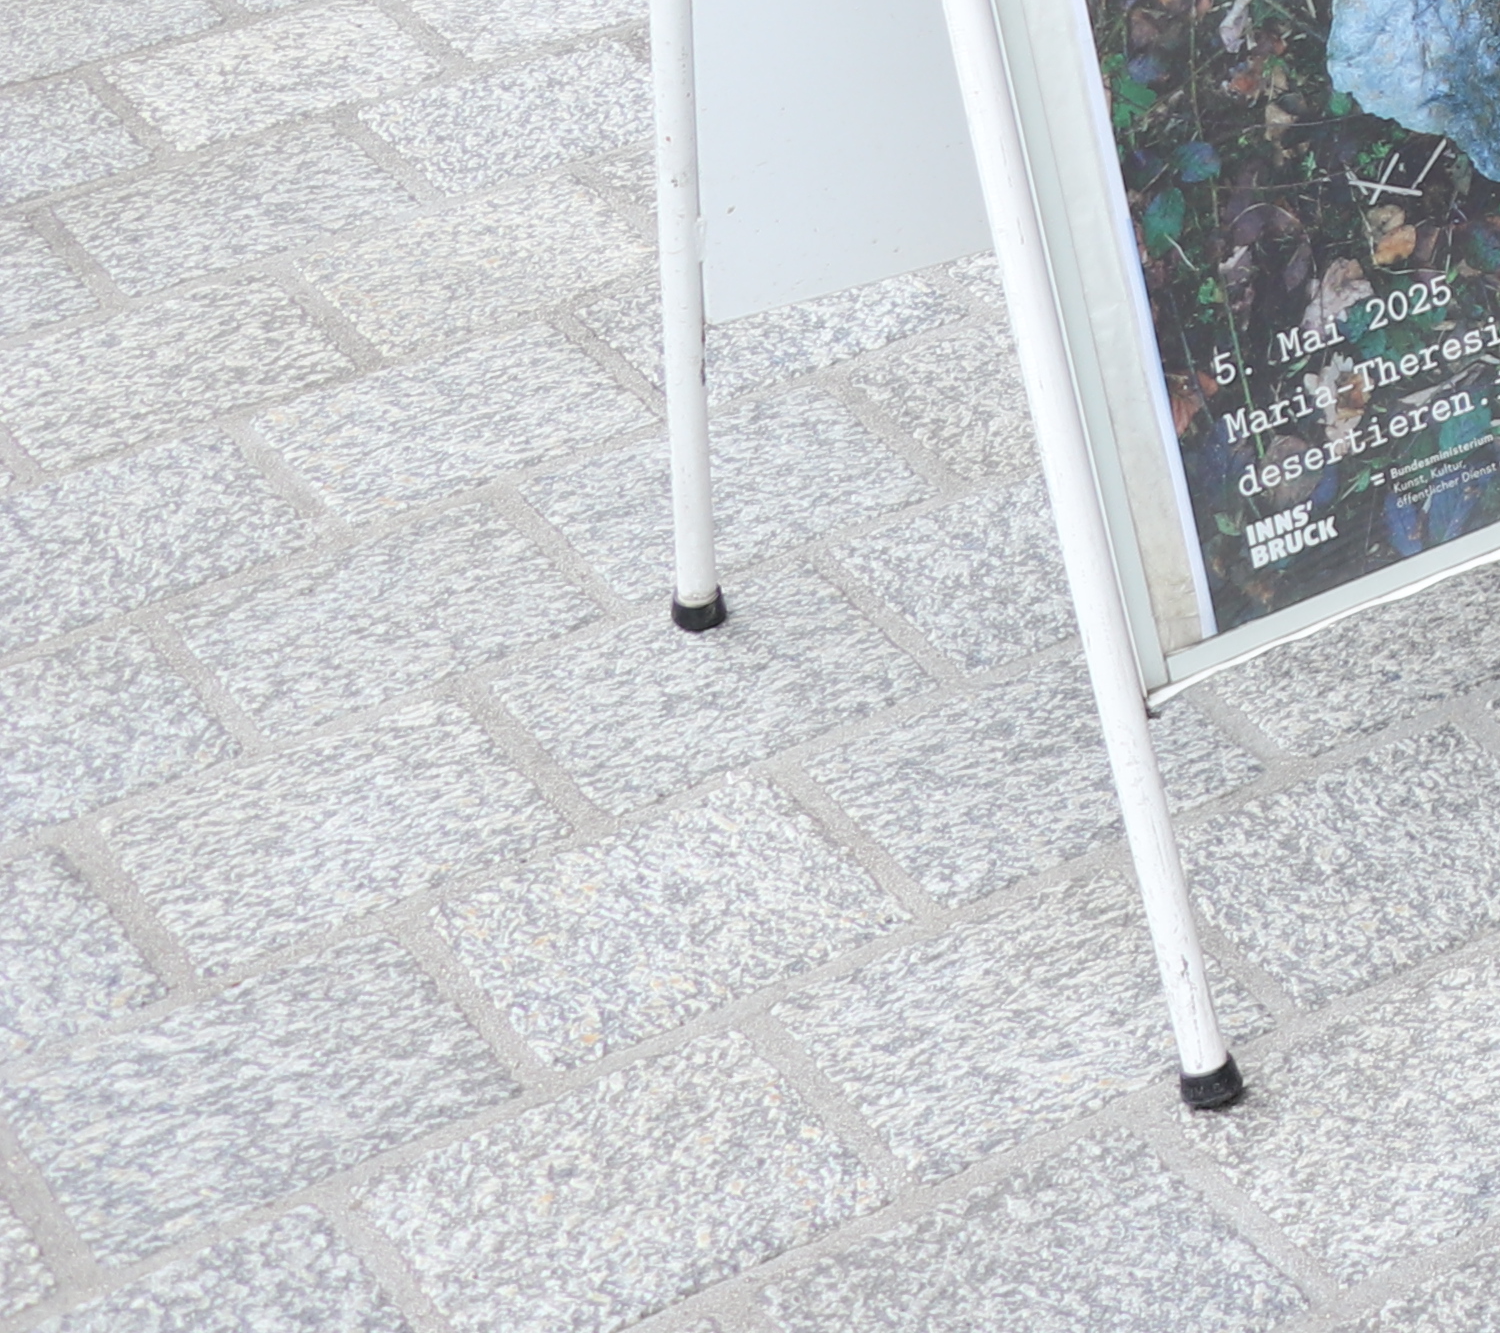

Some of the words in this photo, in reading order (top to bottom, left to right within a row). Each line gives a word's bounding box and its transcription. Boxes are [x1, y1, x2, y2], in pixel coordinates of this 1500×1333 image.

[1212, 345, 1254, 386] 5.
[1278, 313, 1343, 363] Mai
[1364, 275, 1454, 334] 2025
[1390, 432, 1495, 480] Bundesministerium
[1393, 472, 1428, 495] Kunst,
[1430, 459, 1468, 480] Kultur,
[1396, 476, 1460, 509] öffentlicher
[1461, 462, 1498, 484] Dienst
[1245, 500, 1314, 547] INNS'
[1250, 514, 1339, 570] BRUCK
